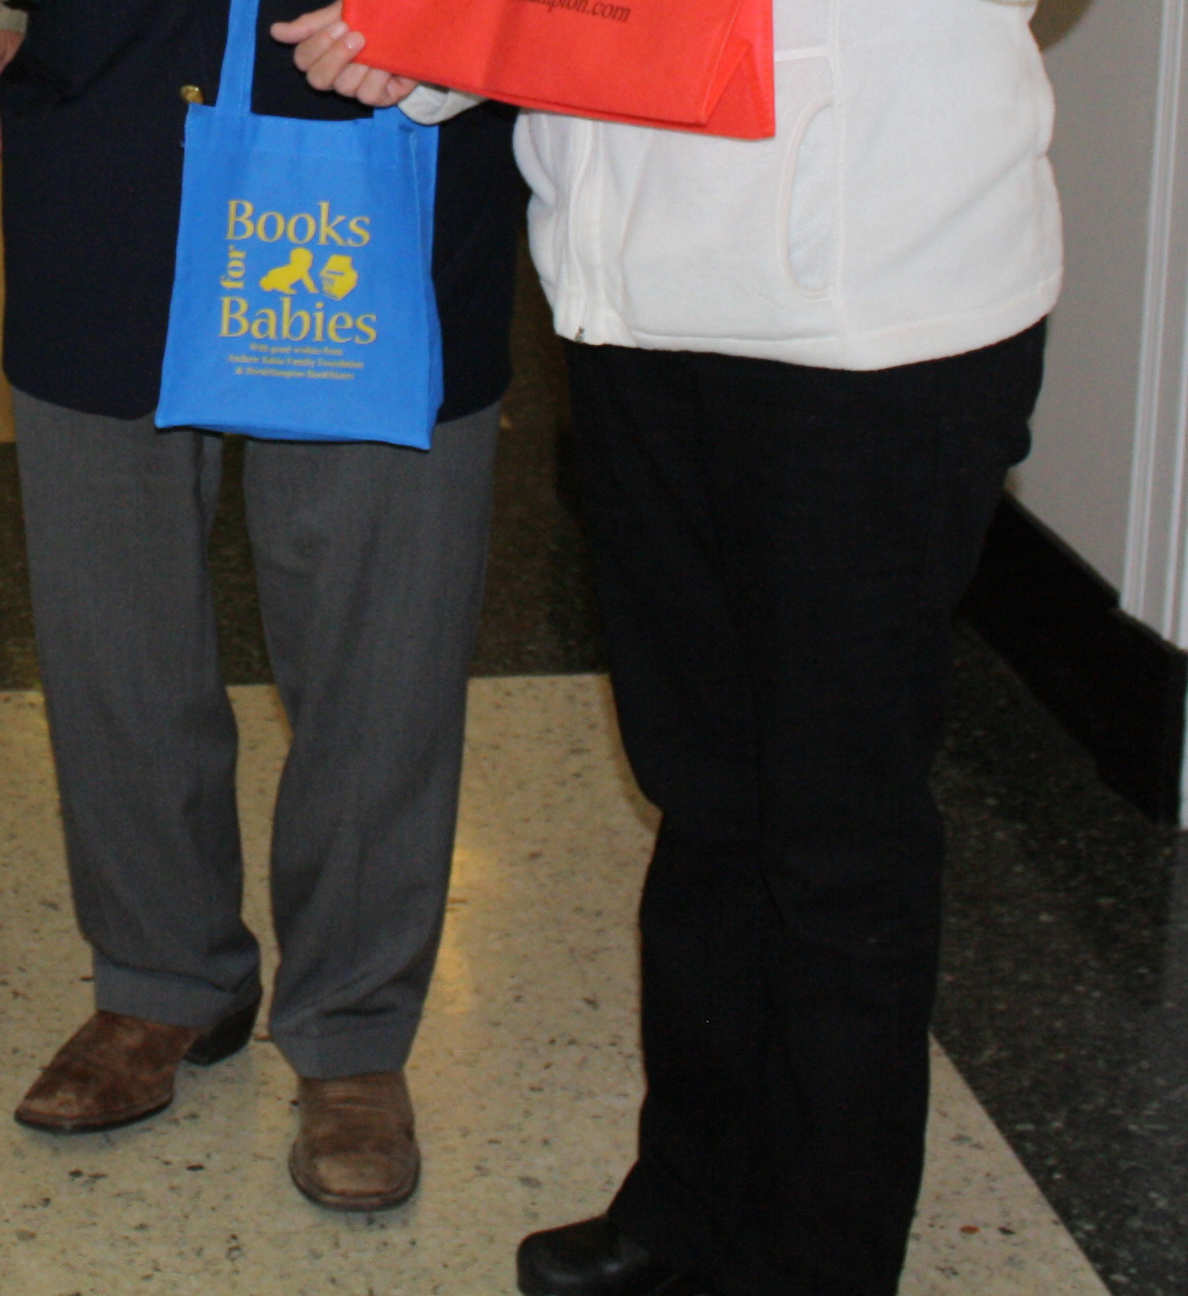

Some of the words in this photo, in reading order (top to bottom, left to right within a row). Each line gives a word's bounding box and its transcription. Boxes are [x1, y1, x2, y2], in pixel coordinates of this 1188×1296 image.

[225, 199, 371, 248] Books
[220, 245, 247, 290] for
[218, 296, 378, 345] Babies
